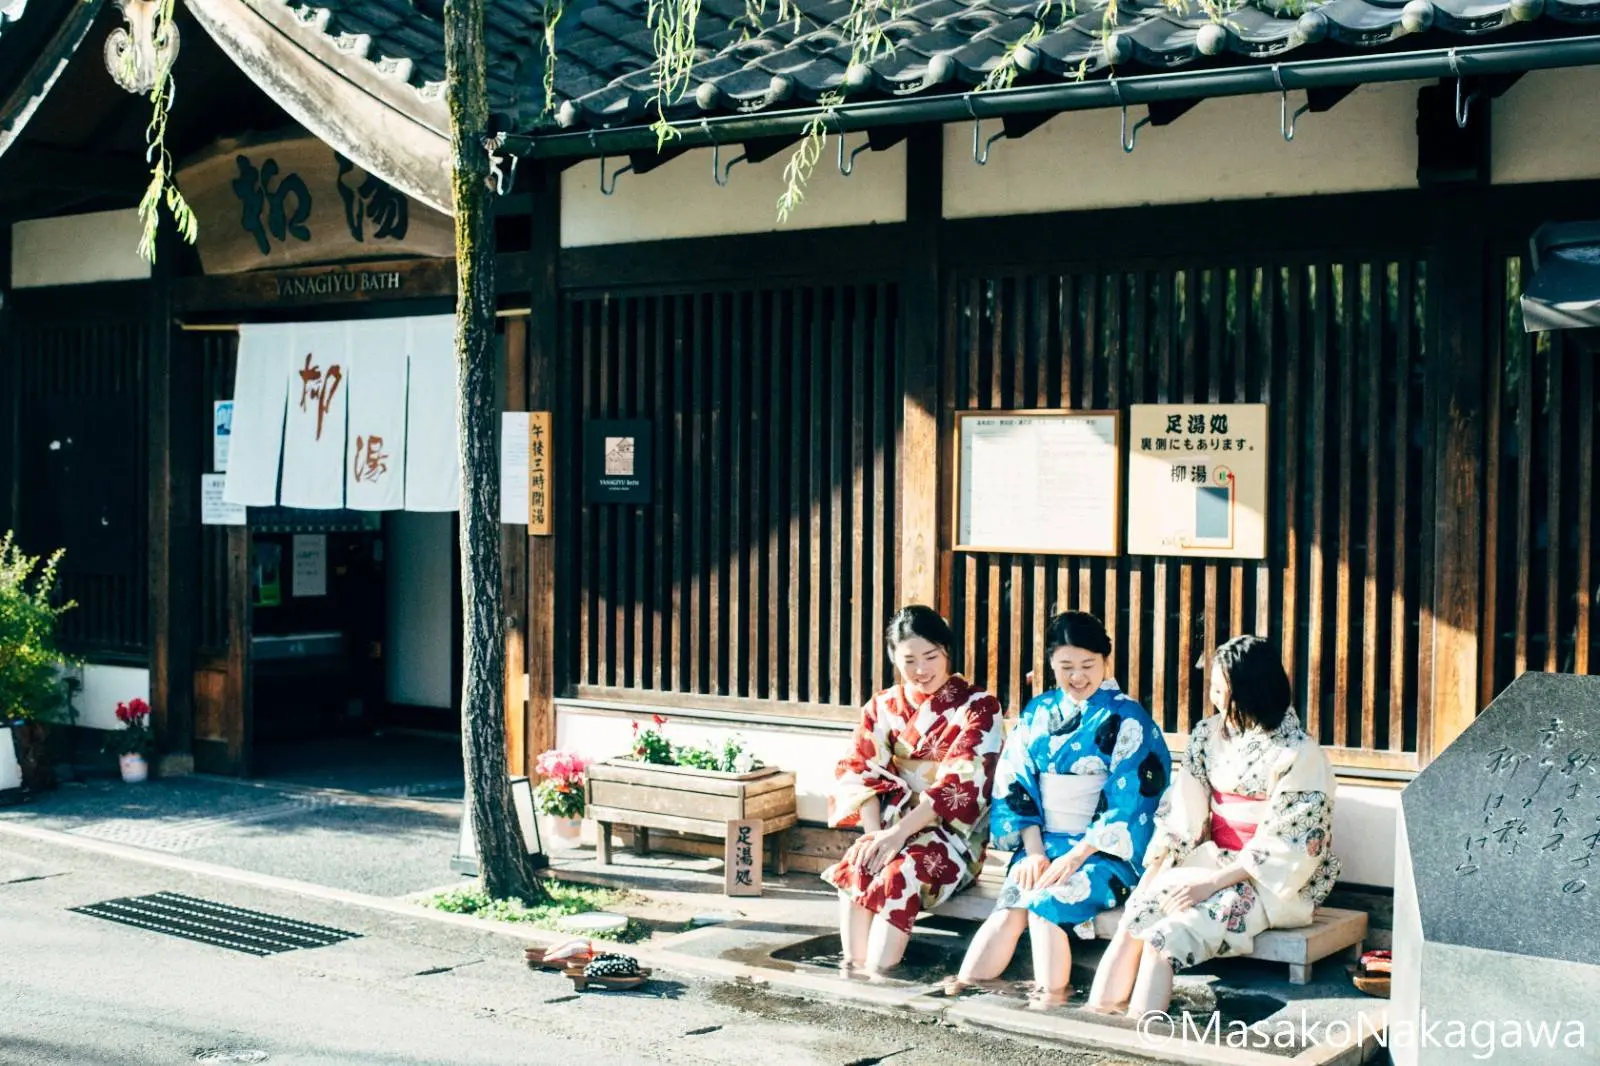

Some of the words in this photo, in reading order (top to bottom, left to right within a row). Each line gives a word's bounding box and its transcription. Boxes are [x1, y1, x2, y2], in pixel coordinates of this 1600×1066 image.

[275, 273, 356, 296] YANAGIYU
[361, 272, 399, 290] BATH
[1166, 414, 1229, 434] 足湯処
[1141, 438, 1255, 451] 裏側にもあります。
[1171, 464, 1207, 483] 柳湯
[736, 826, 753, 886] 足湯処
